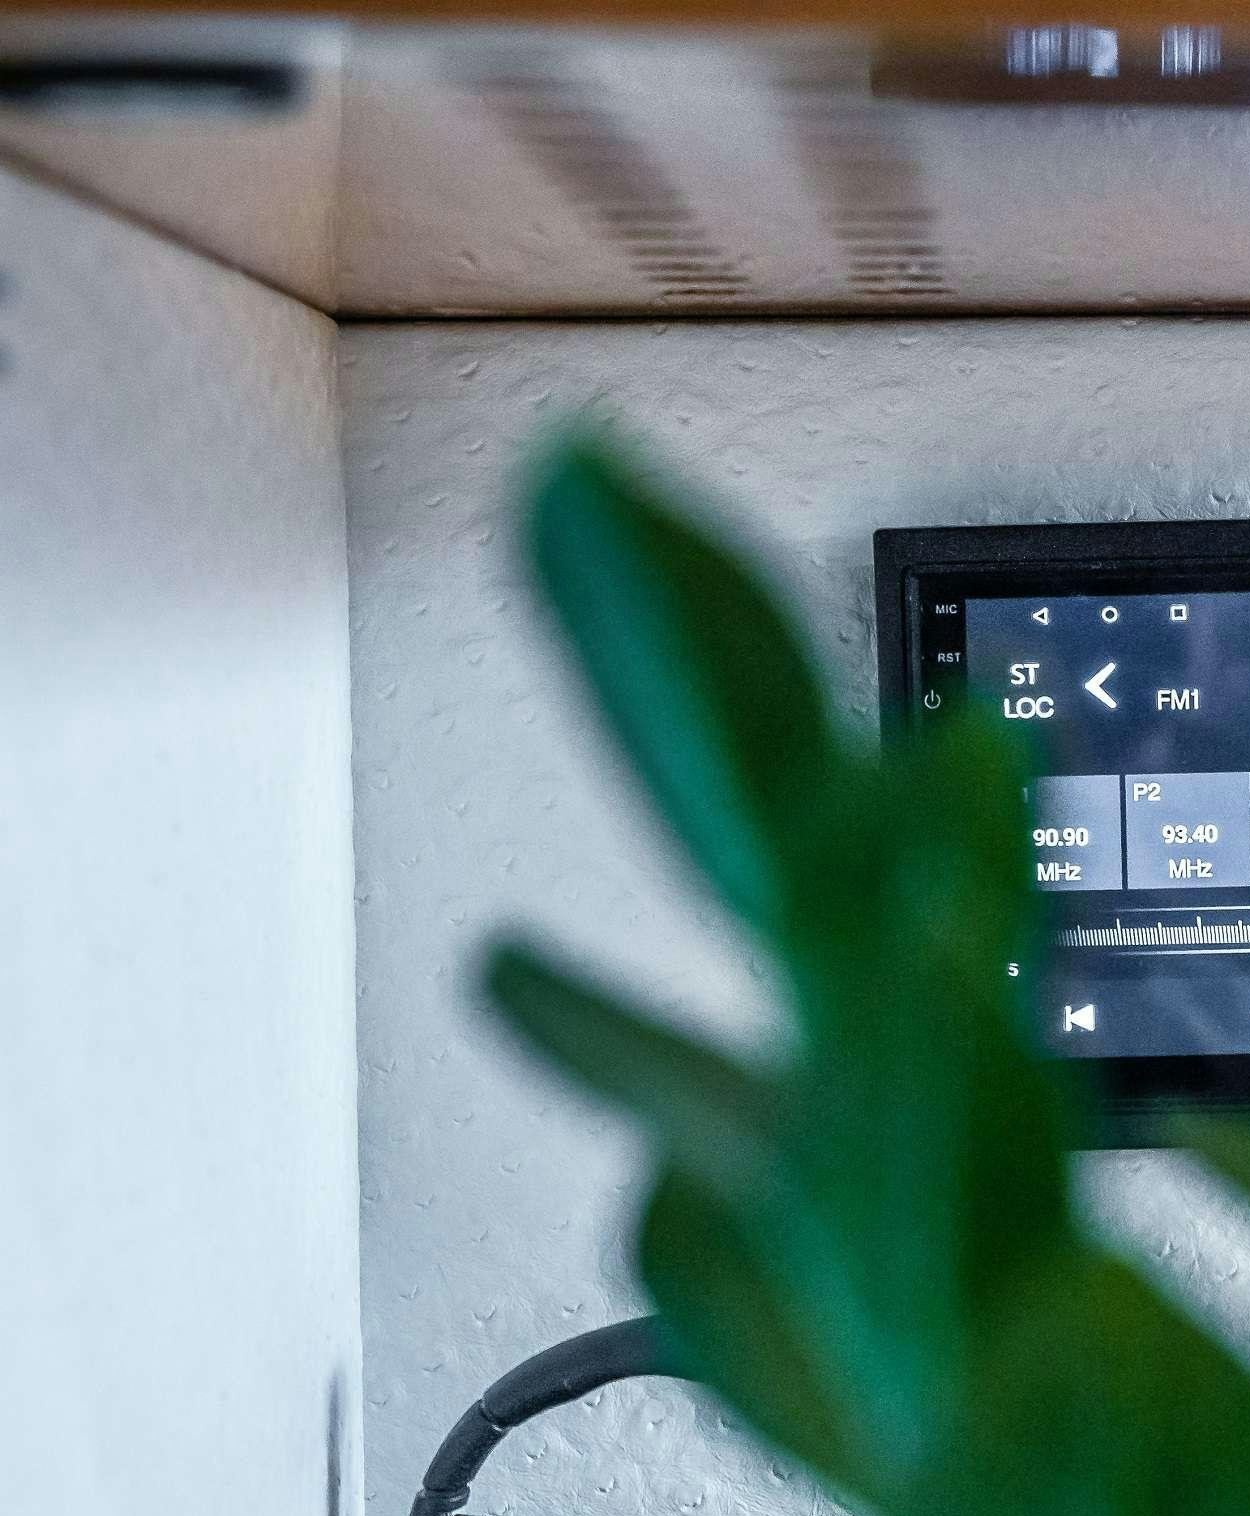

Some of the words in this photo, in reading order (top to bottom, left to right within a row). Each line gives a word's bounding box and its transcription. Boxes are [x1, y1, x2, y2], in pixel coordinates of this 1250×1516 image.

[935, 604, 958, 615] MIC
[937, 652, 961, 663] RST
[1009, 663, 1040, 685] ST
[1003, 695, 1055, 719] LOC
[1157, 688, 1200, 711] FM1
[1133, 782, 1161, 802] P2
[1033, 827, 1089, 847] 90.90
[1162, 824, 1219, 844] 93.40
[1037, 862, 1082, 882] MHz
[1168, 858, 1213, 879] MHz
